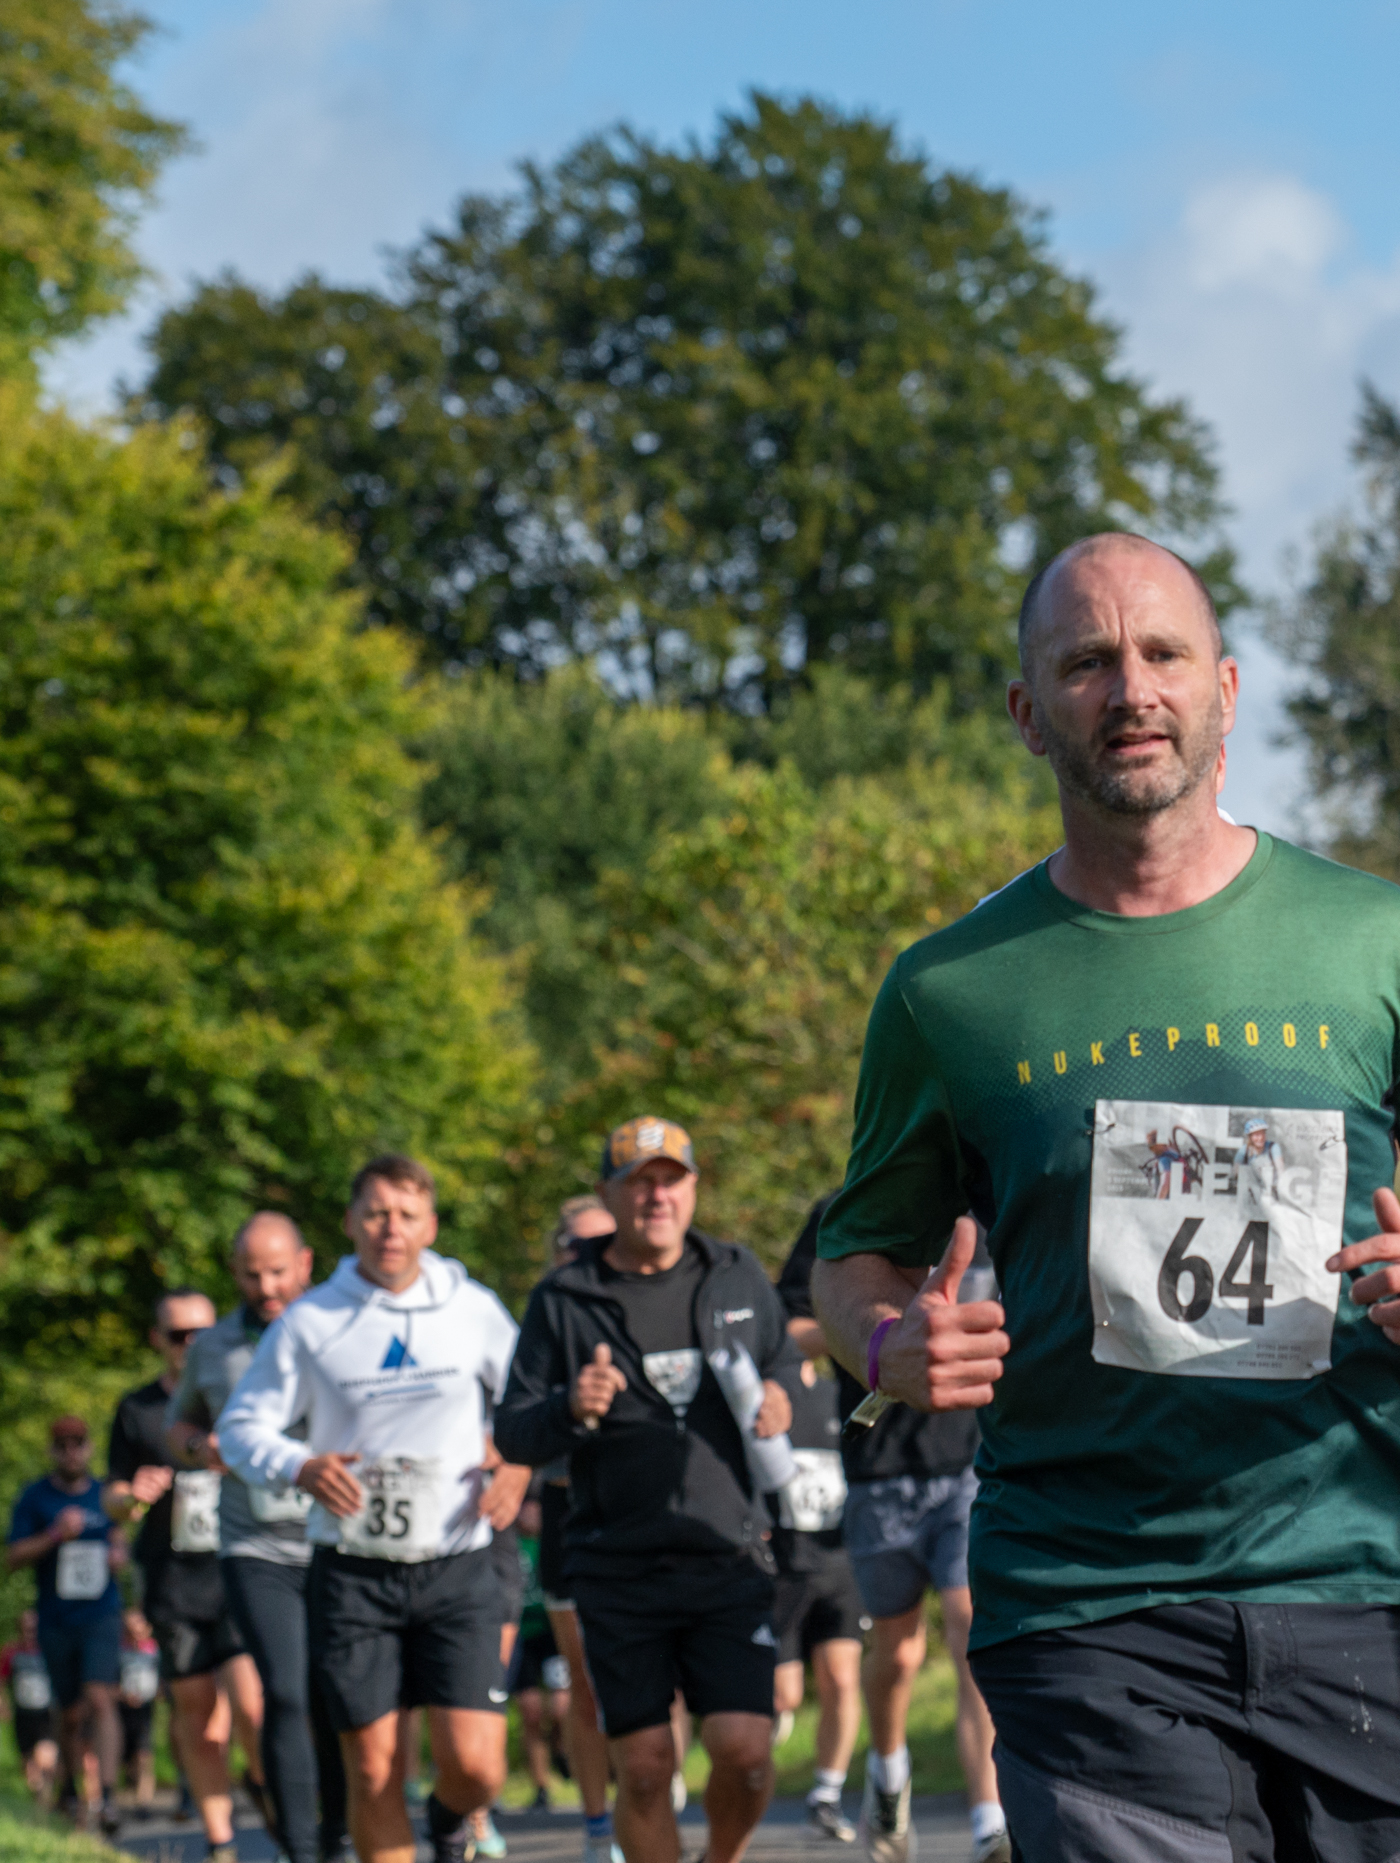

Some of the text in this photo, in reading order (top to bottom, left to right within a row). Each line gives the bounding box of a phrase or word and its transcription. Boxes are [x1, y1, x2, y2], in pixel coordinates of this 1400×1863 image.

[1017, 1021, 1330, 1085] NUKEPROOF
[1157, 1217, 1275, 1327] 64
[366, 1497, 411, 1539] 35
